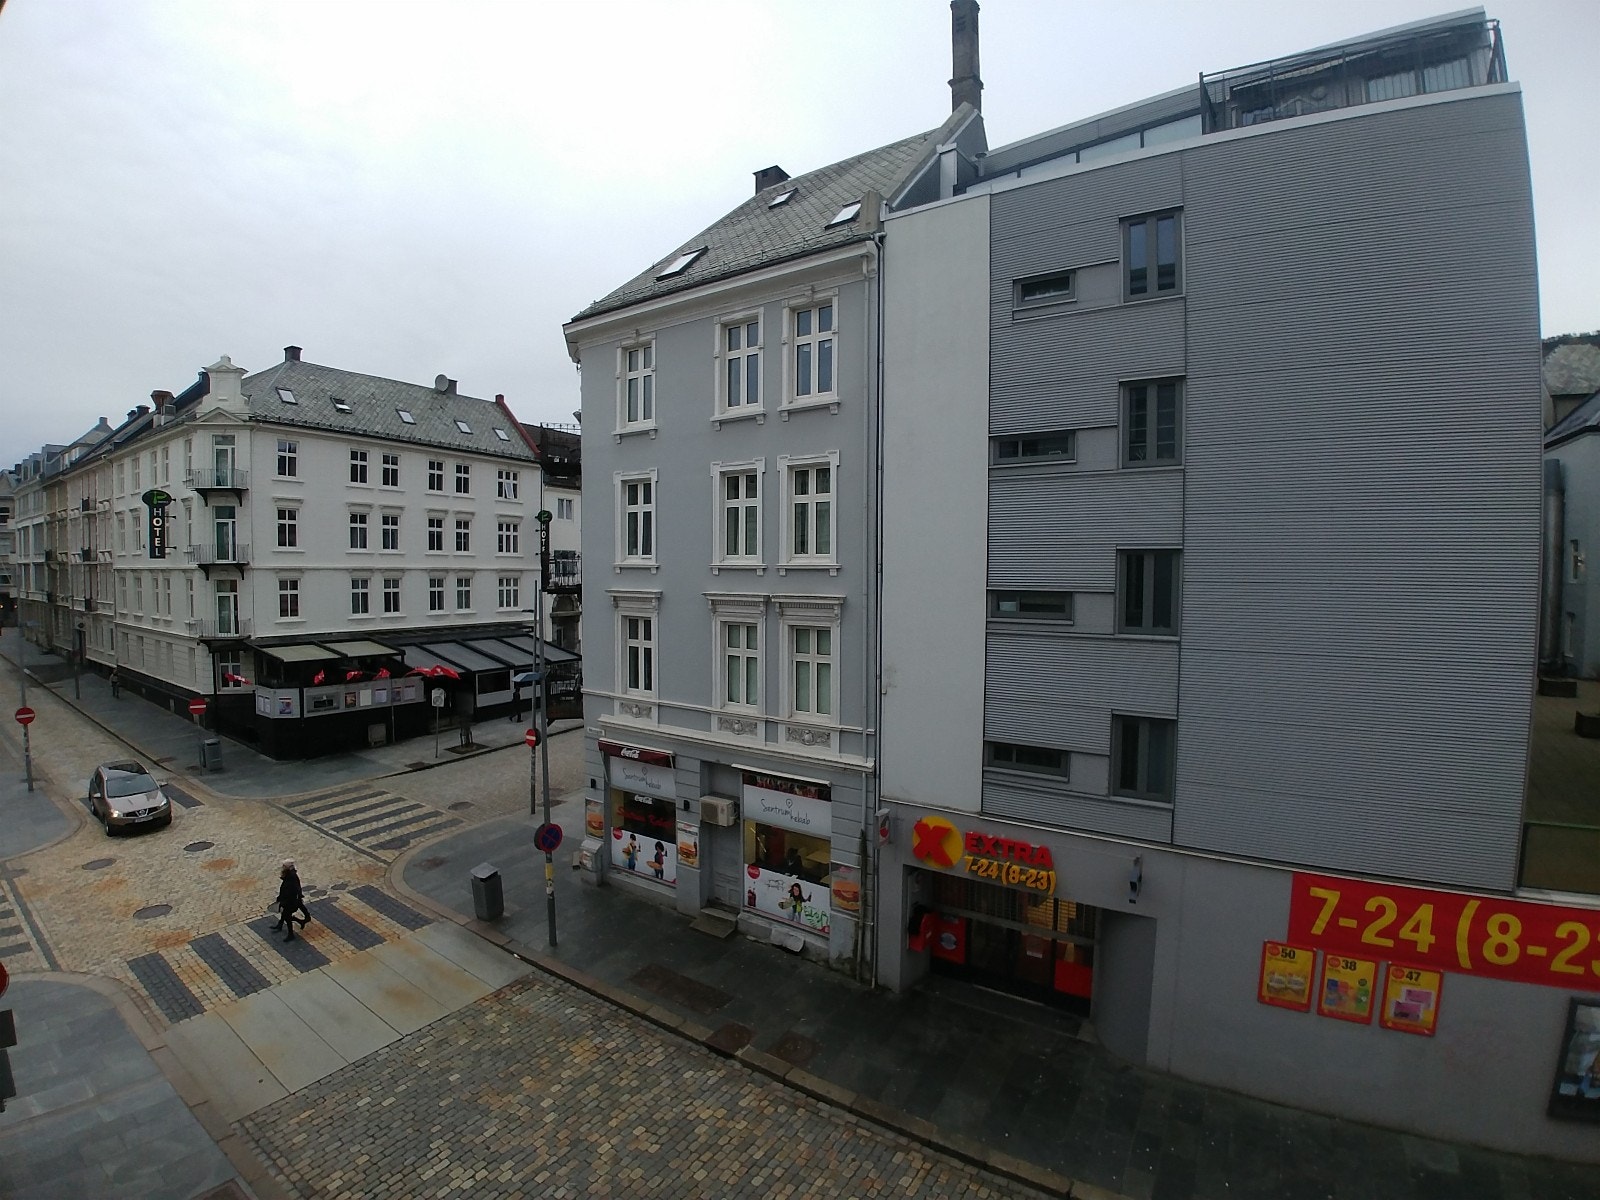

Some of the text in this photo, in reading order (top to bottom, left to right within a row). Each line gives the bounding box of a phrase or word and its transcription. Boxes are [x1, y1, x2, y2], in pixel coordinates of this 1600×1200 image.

[153, 507, 163, 556] HOTEL
[964, 830, 1053, 868] EXTRA
[964, 855, 1057, 896] 7-24 (8-23)
[1309, 887, 1600, 976] 7-24 (8-2
[1281, 947, 1296, 960] 50
[1341, 959, 1357, 972] 38
[1405, 971, 1421, 983] 47
